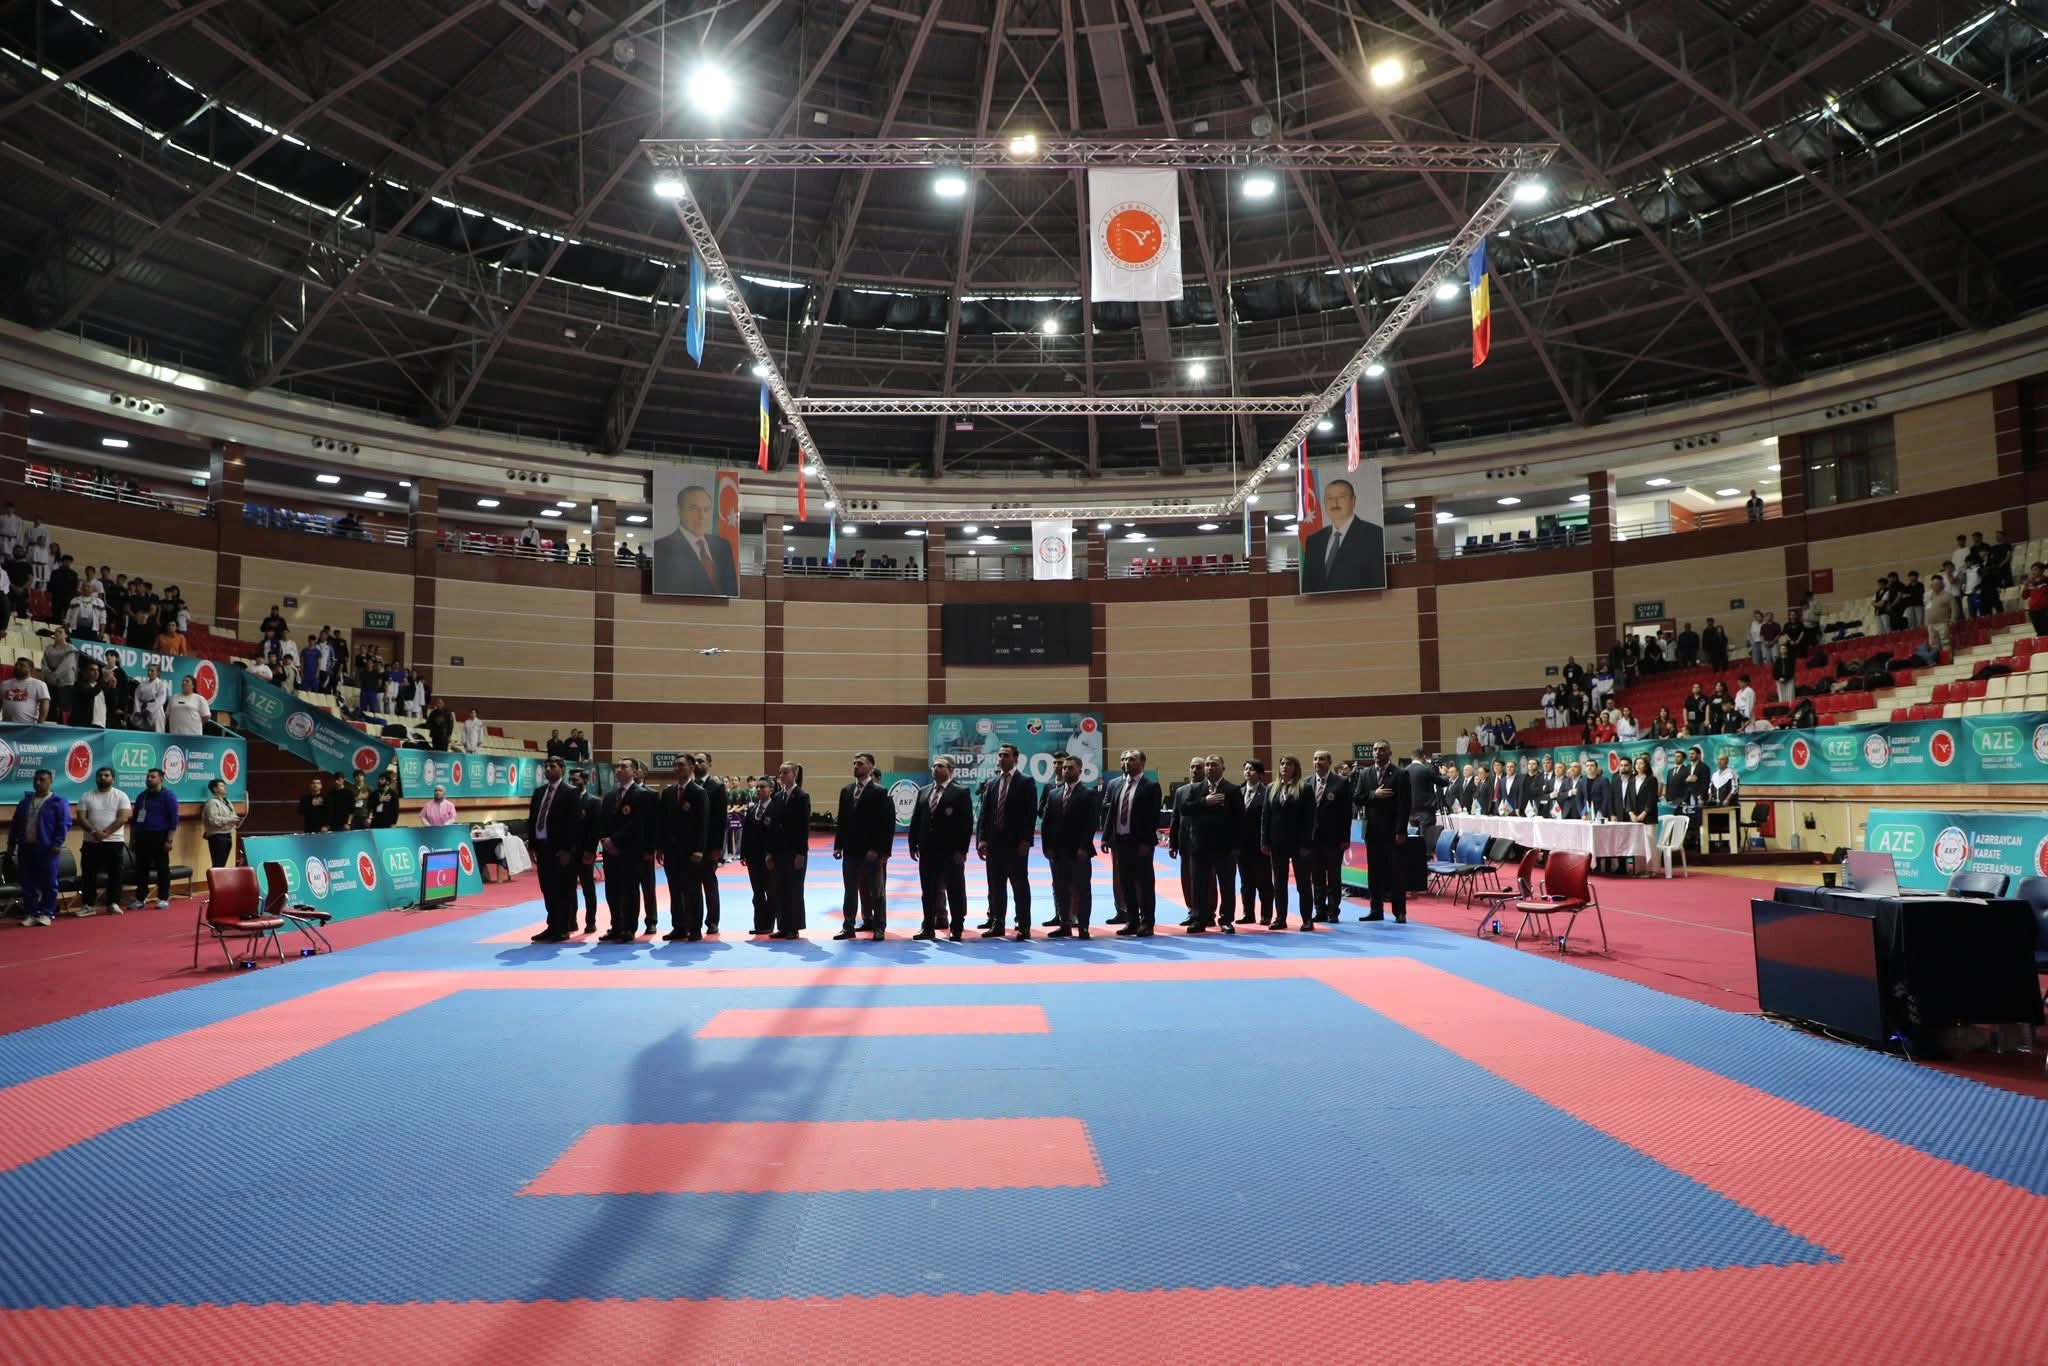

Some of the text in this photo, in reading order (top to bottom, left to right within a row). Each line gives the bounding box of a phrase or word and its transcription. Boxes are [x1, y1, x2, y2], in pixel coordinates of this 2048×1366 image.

[246, 691, 278, 715] AZE
[938, 721, 957, 730] AZE
[1828, 741, 1852, 756] AZE
[1981, 732, 2015, 750] AZE
[120, 748, 149, 768] AZE
[977, 754, 996, 764] PRI
[1879, 831, 1915, 852] AZE
[1975, 834, 2022, 846] AZƏRBAYCAN
[389, 852, 411, 871] AZE
[1973, 848, 2000, 860] KARATE
